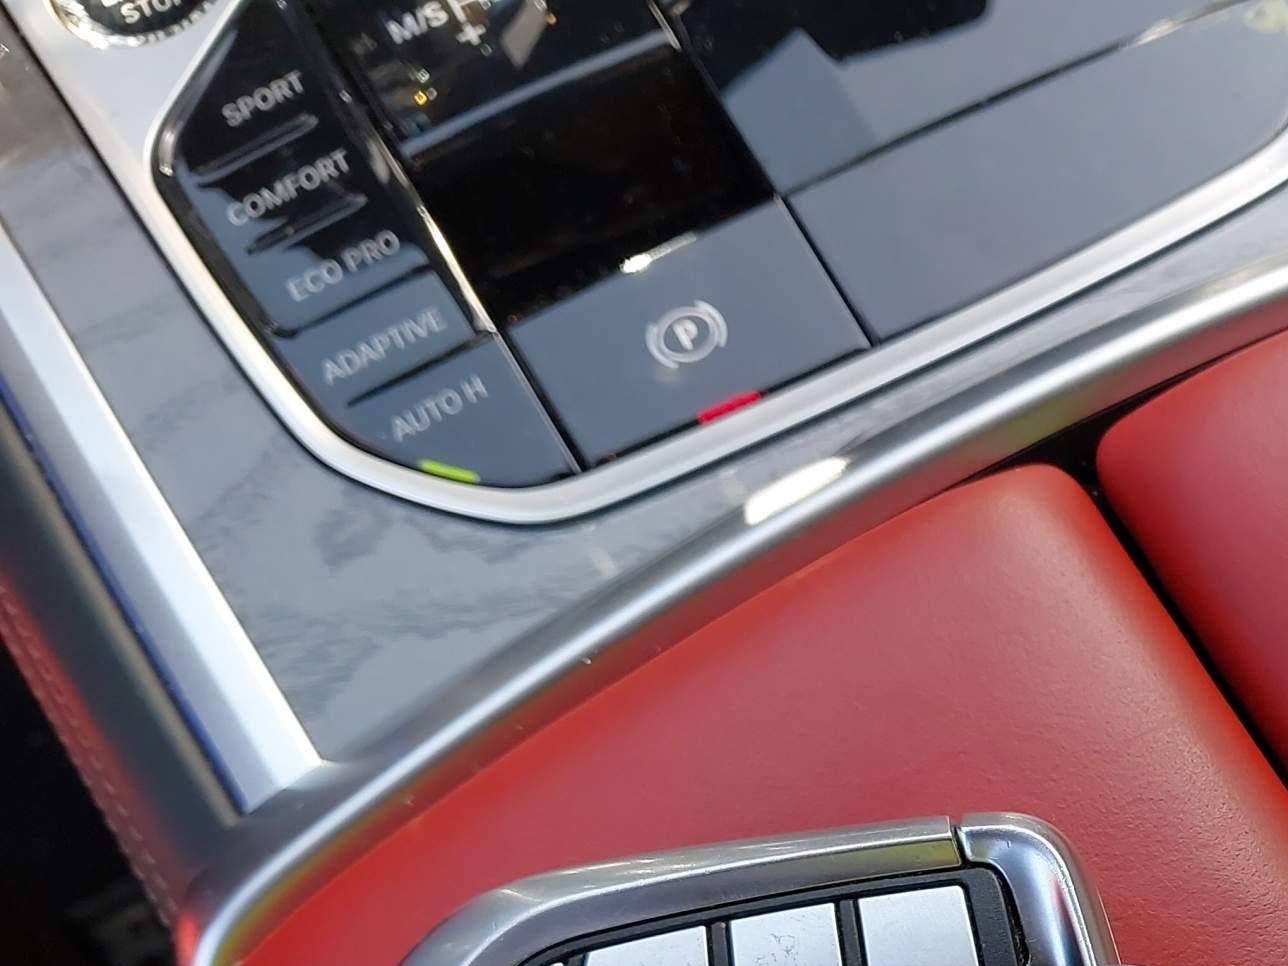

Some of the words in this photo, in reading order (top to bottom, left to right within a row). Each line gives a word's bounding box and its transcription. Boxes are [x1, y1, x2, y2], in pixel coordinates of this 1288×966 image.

[120, 0, 182, 24] STO
[221, 70, 304, 127] SPORT
[227, 147, 351, 226] COMFORT
[285, 258, 344, 302] ECO
[342, 229, 400, 272] PRO
[321, 306, 448, 385] ADAPTIVE
[390, 387, 463, 443] AUTO
[461, 374, 489, 403] H
